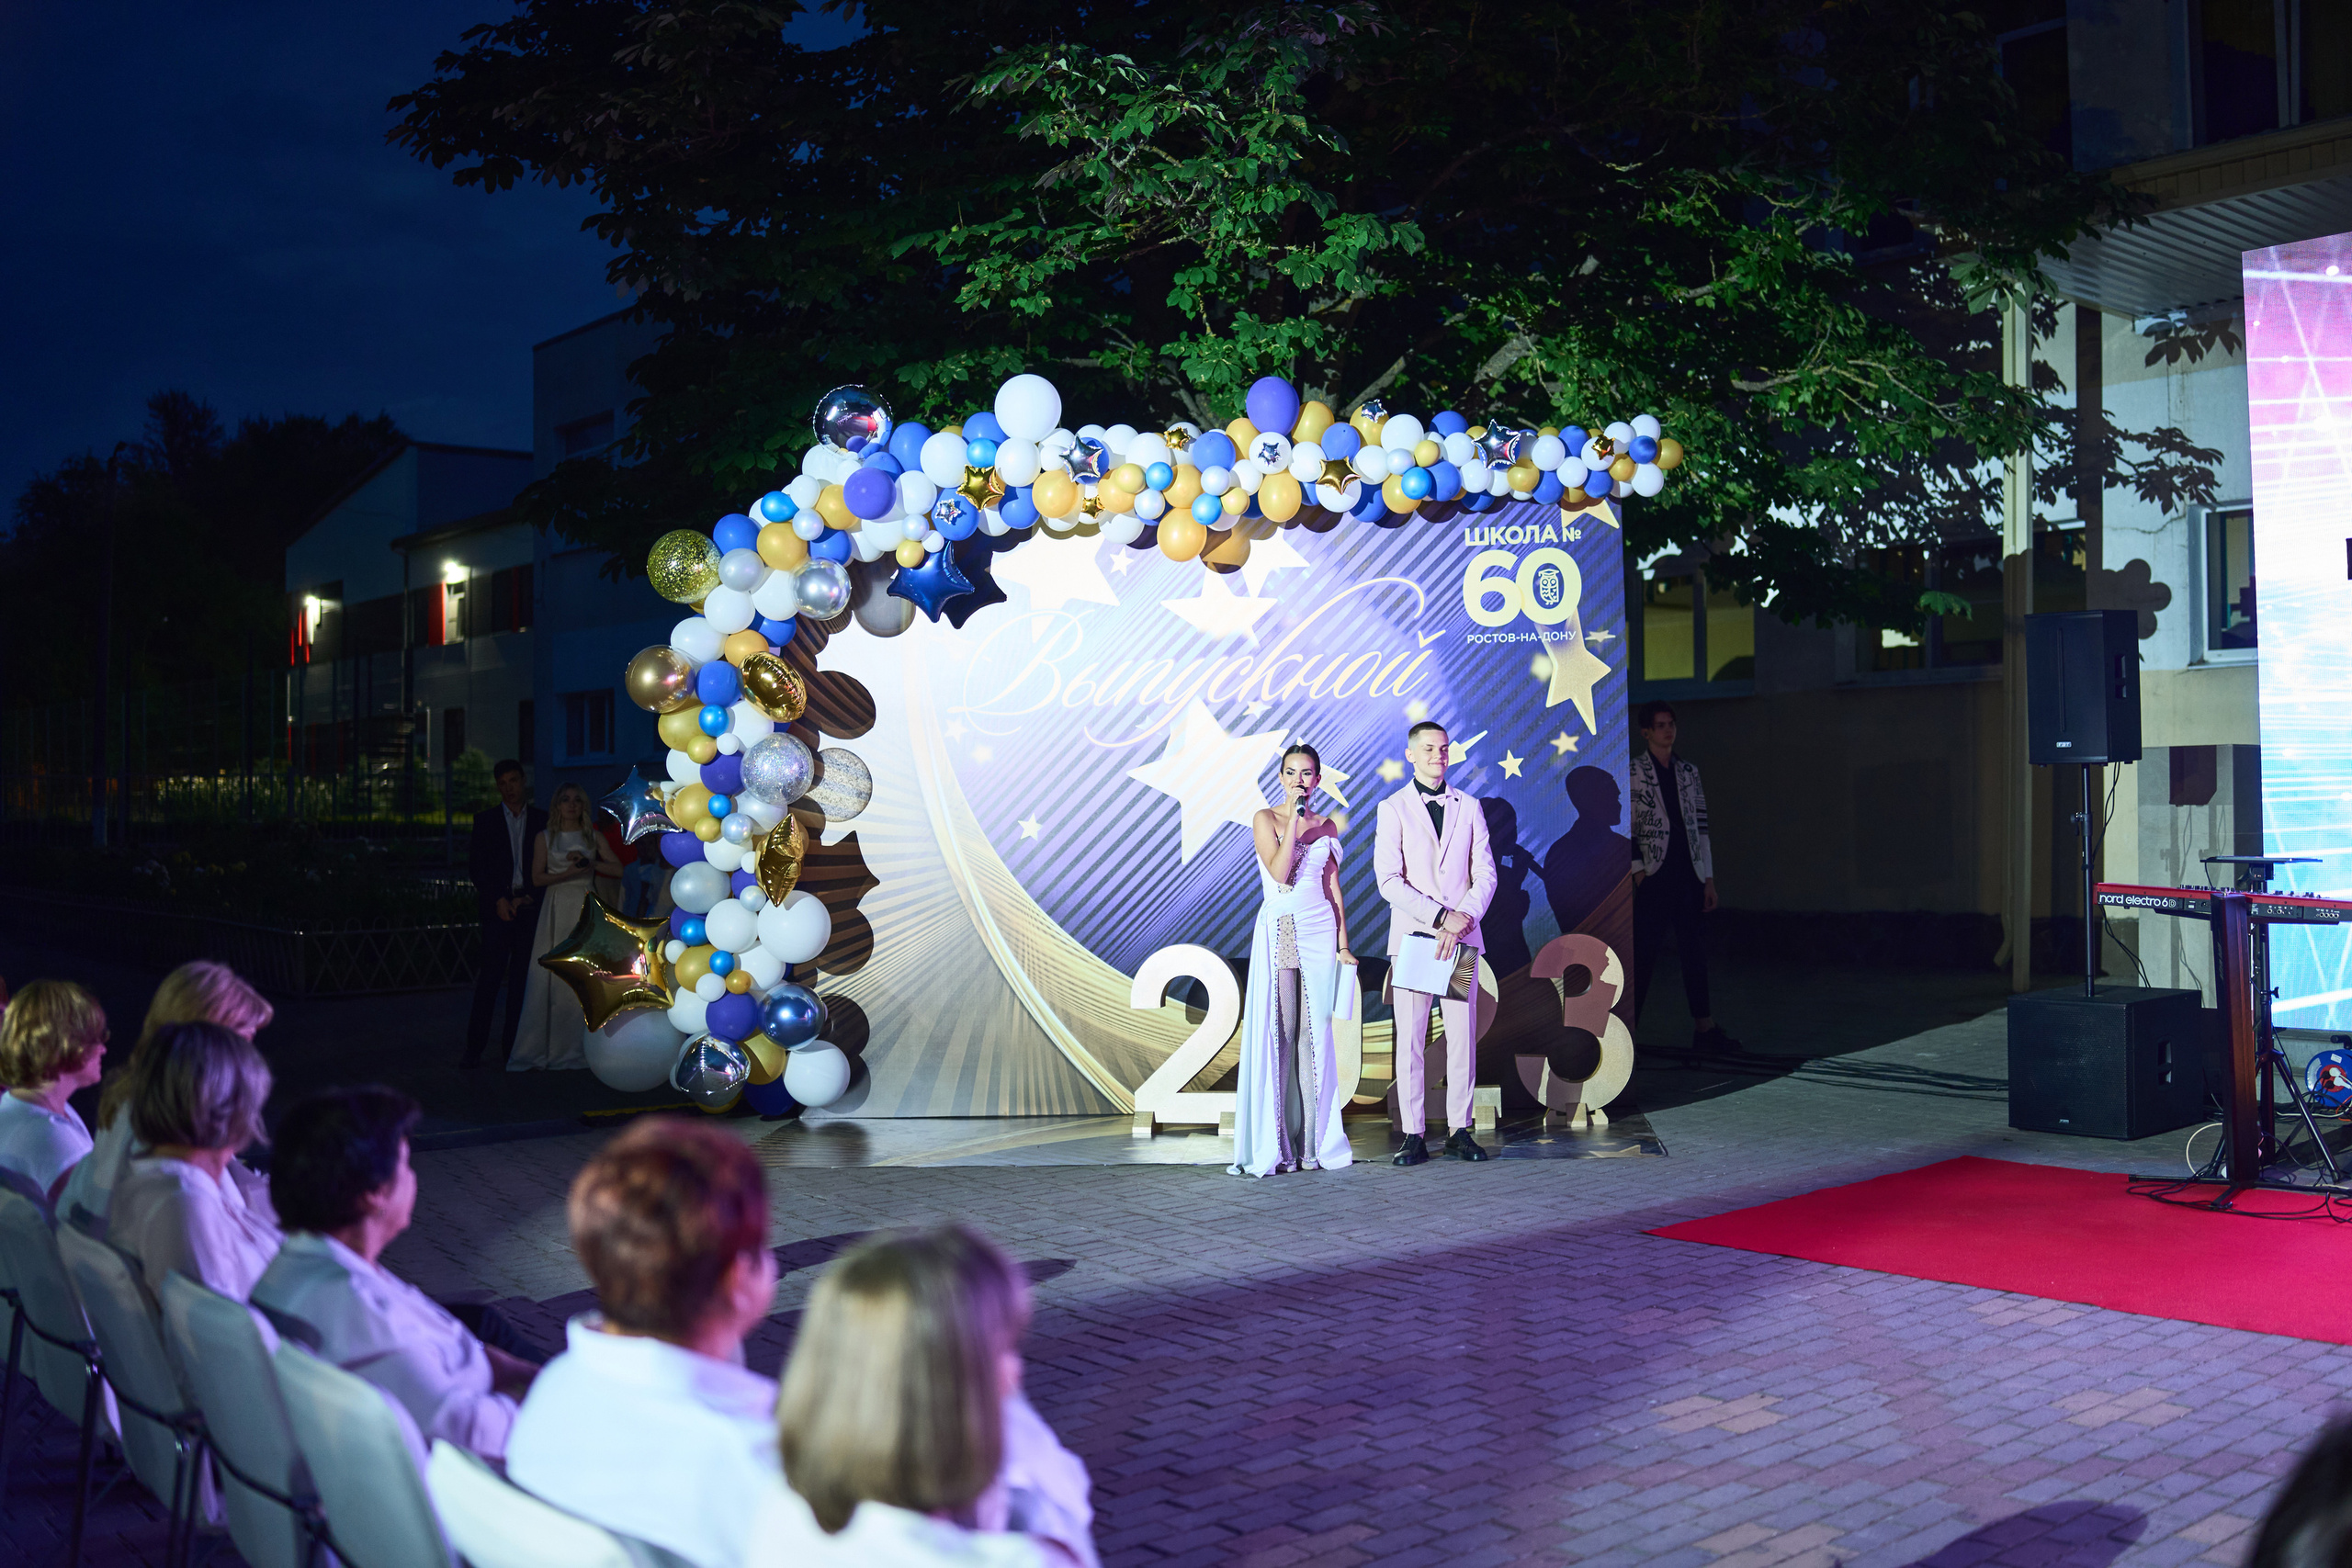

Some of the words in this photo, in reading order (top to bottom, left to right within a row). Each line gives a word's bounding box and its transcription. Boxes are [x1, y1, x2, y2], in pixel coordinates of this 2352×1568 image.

[1464, 525, 1558, 546] ШКОЛА
[1562, 526, 1582, 542] №
[1463, 547, 1582, 627] 60
[1467, 631, 1577, 644] РОСТОВ-НА-ДОНУ
[946, 577, 1446, 748] Выпускной
[2099, 894, 2123, 904] nord
